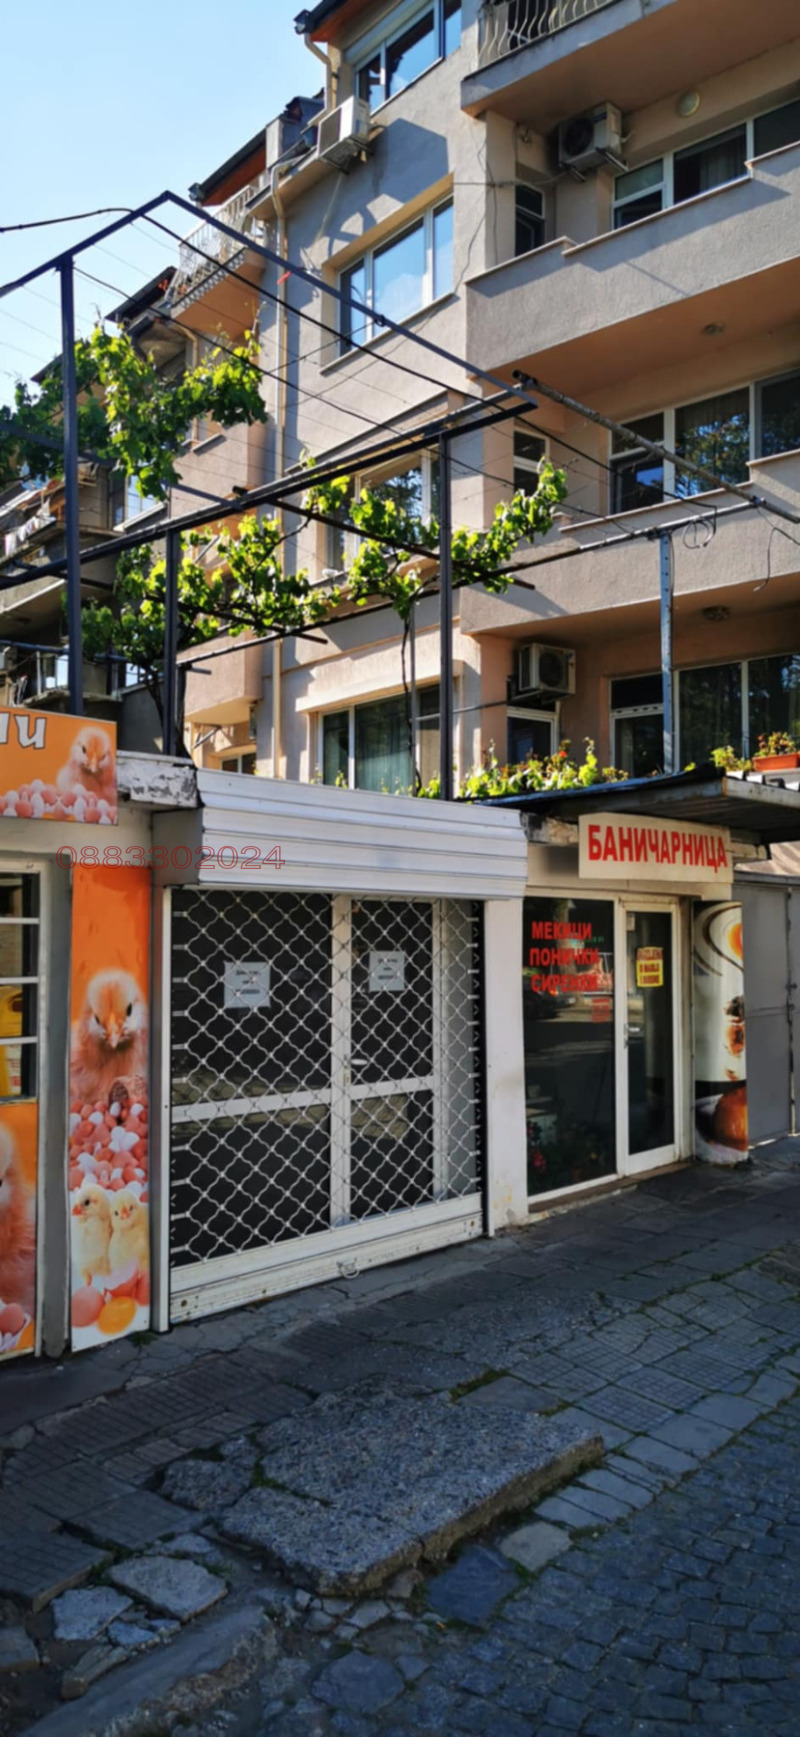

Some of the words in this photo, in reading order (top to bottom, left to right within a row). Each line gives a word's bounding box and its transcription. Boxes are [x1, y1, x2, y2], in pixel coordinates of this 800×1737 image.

[587, 824, 728, 873] БАНИЧАРНИЦА
[531, 921, 592, 941] МЕКИЦИ
[529, 948, 599, 967] ПОНИЧКИ
